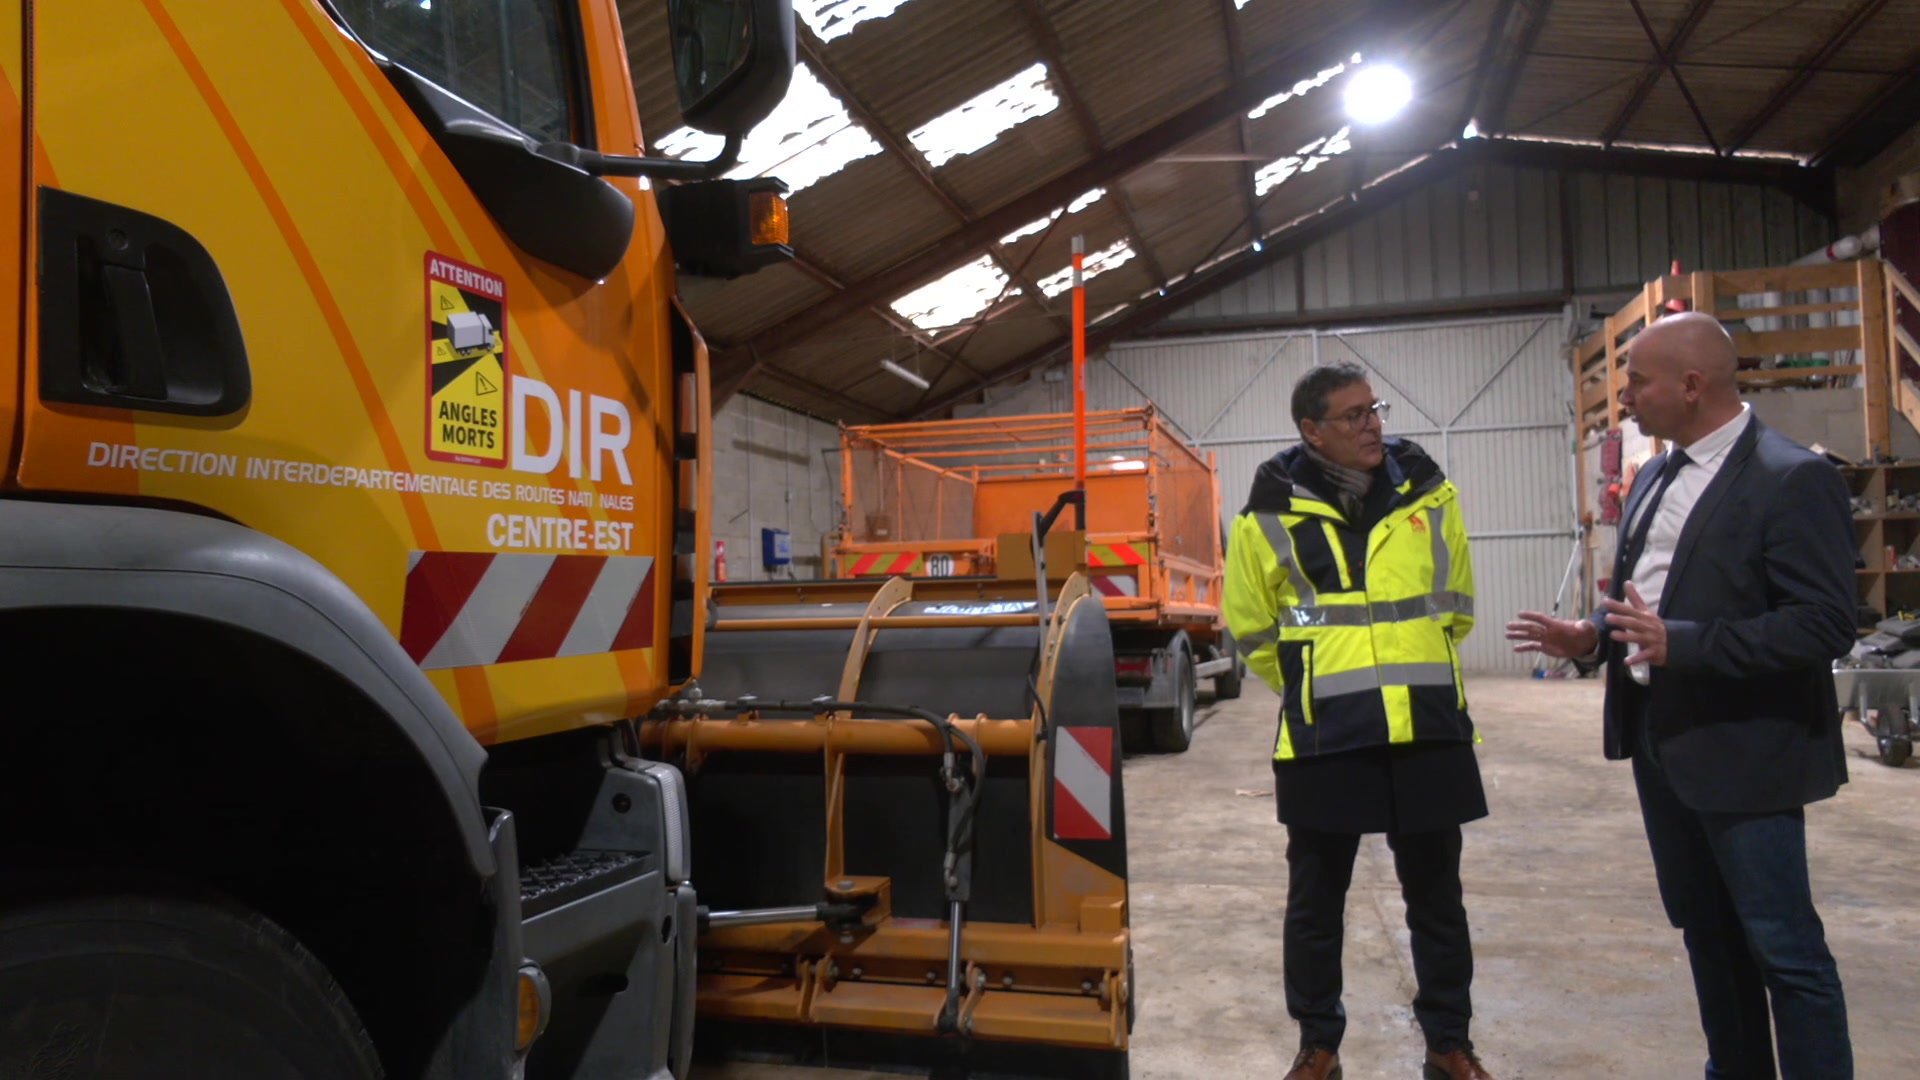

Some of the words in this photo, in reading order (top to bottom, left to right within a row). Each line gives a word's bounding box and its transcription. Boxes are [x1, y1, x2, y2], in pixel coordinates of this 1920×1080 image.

[430, 259, 503, 297] ATTENTION
[439, 401, 498, 427] ANGLES
[511, 374, 633, 486] DIR
[442, 424, 495, 449] MORTS
[87, 442, 238, 477] DIRECTION
[245, 457, 478, 498] INTERDEPARTEMENTALE
[482, 481, 512, 500] DES
[517, 485, 565, 506] ROUTES
[486, 513, 634, 550] CENTRE-EST
